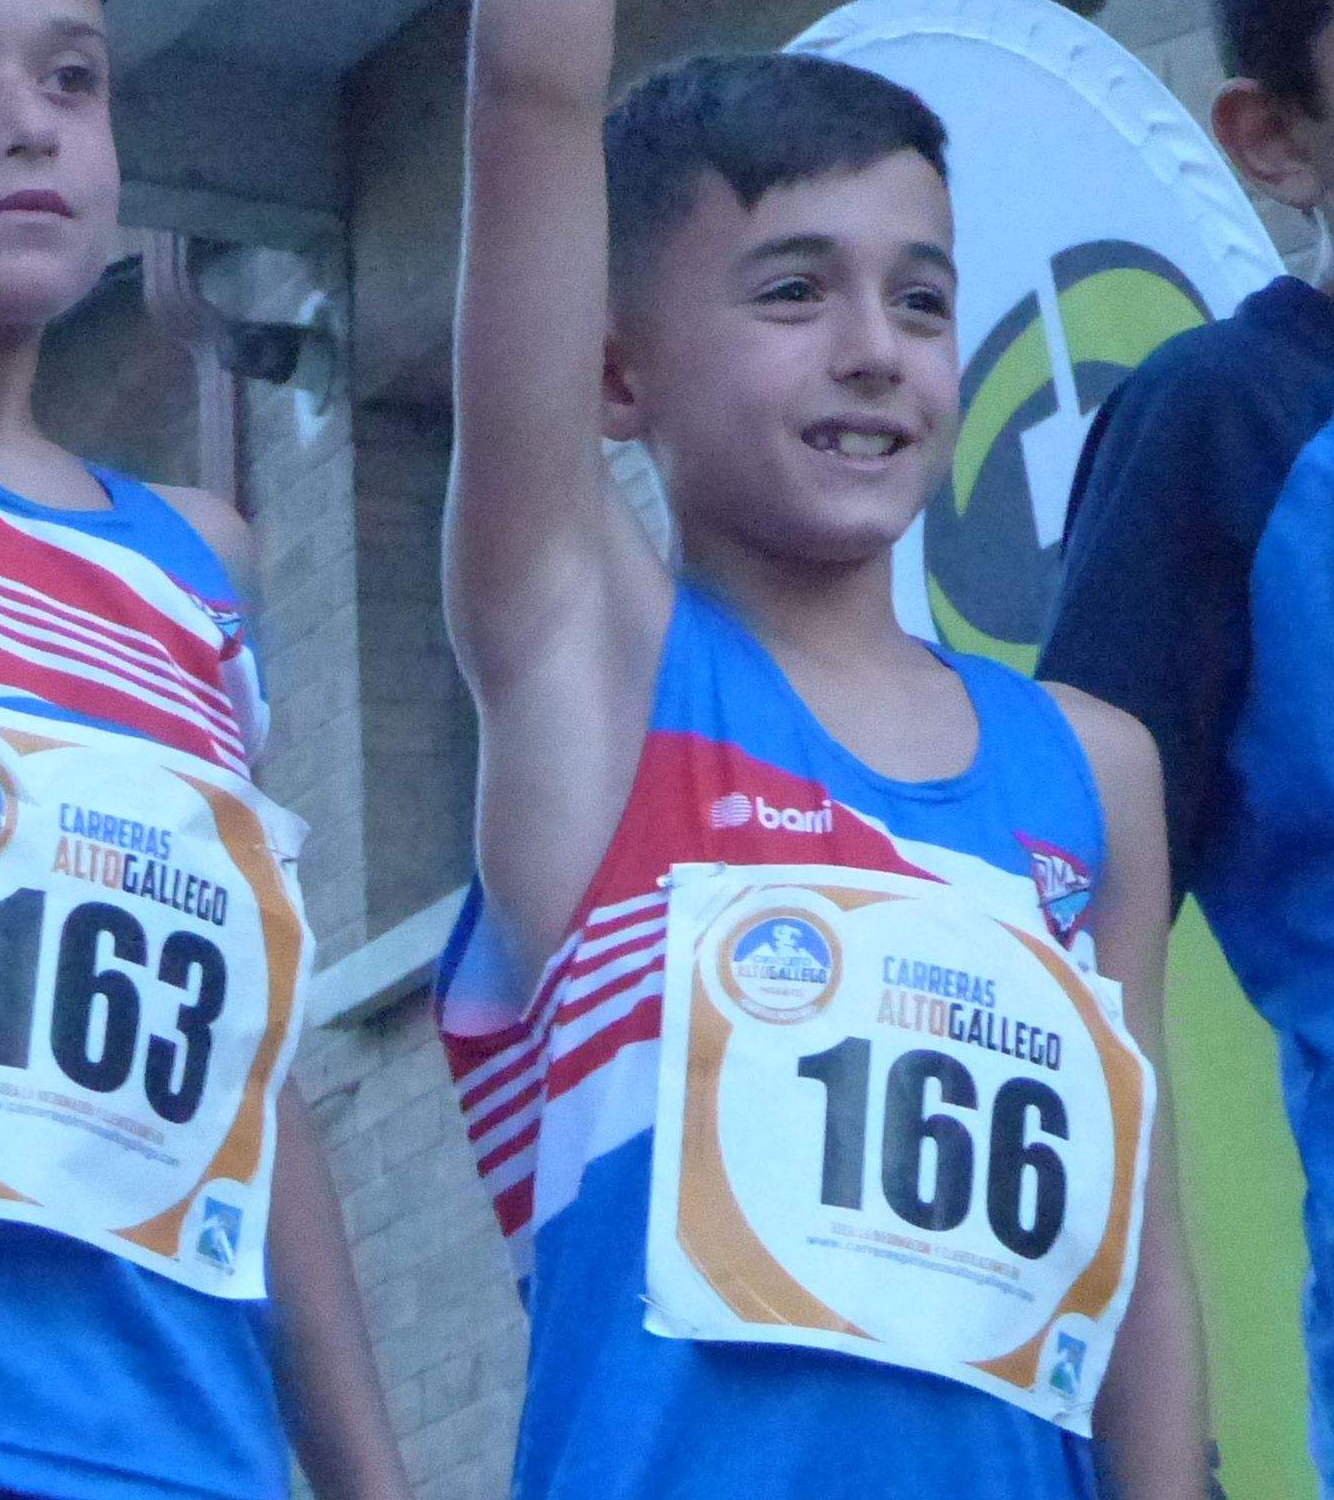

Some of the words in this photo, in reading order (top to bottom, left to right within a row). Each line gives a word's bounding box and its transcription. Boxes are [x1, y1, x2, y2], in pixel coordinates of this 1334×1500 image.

[60, 803, 171, 860] CARRERAS
[52, 835, 229, 927] ALTOGALLEGO
[883, 955, 995, 1008] CARRERAS
[877, 988, 1063, 1071] ALTOGALLEGO
[797, 1035, 1069, 1260] 166
